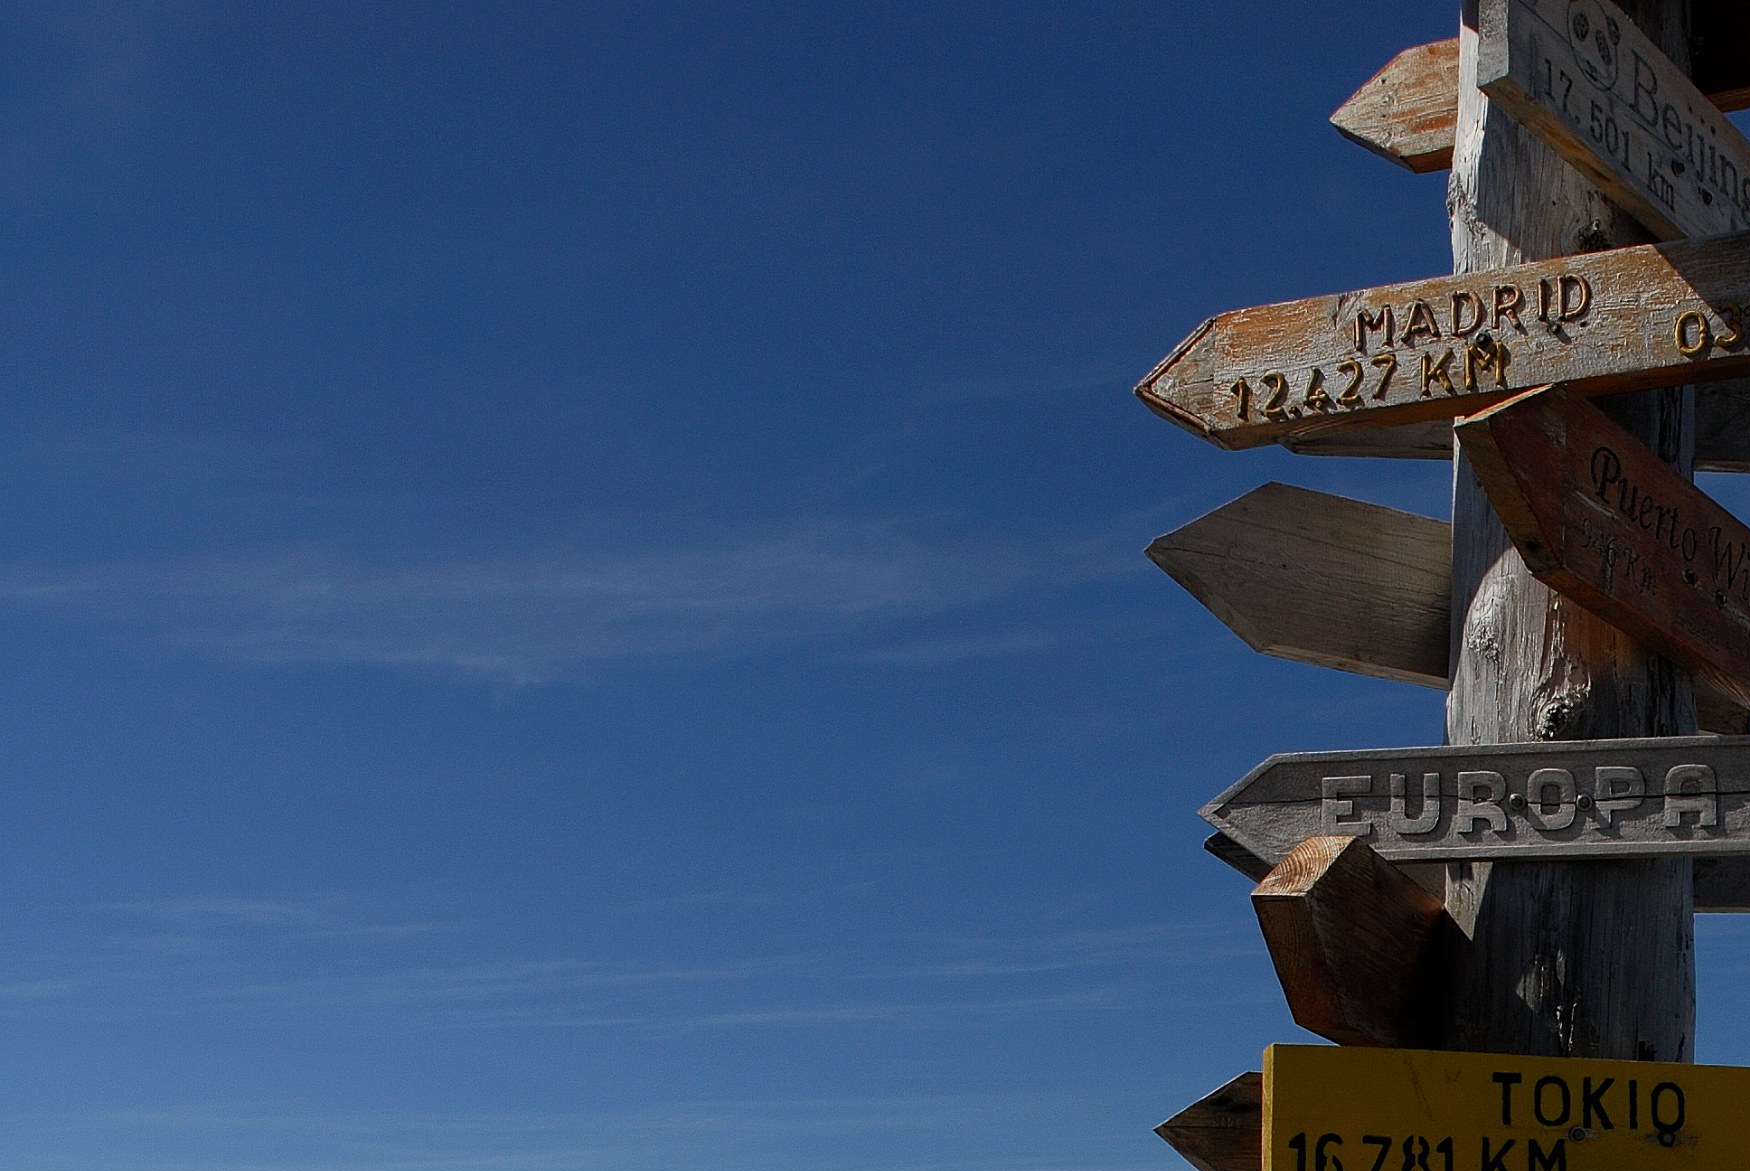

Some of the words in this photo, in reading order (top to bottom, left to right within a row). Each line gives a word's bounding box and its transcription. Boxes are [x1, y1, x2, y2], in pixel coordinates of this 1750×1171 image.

[1544, 58, 1631, 172] 17.501
[1646, 152, 1676, 212] km
[1353, 273, 1592, 351] MADRID
[1231, 353, 1398, 422] 12.427
[1421, 340, 1506, 400] KM
[1590, 446, 1697, 561] Puerto
[1320, 763, 1718, 837] EUROPA
[1492, 1071, 1686, 1132] TOKIO
